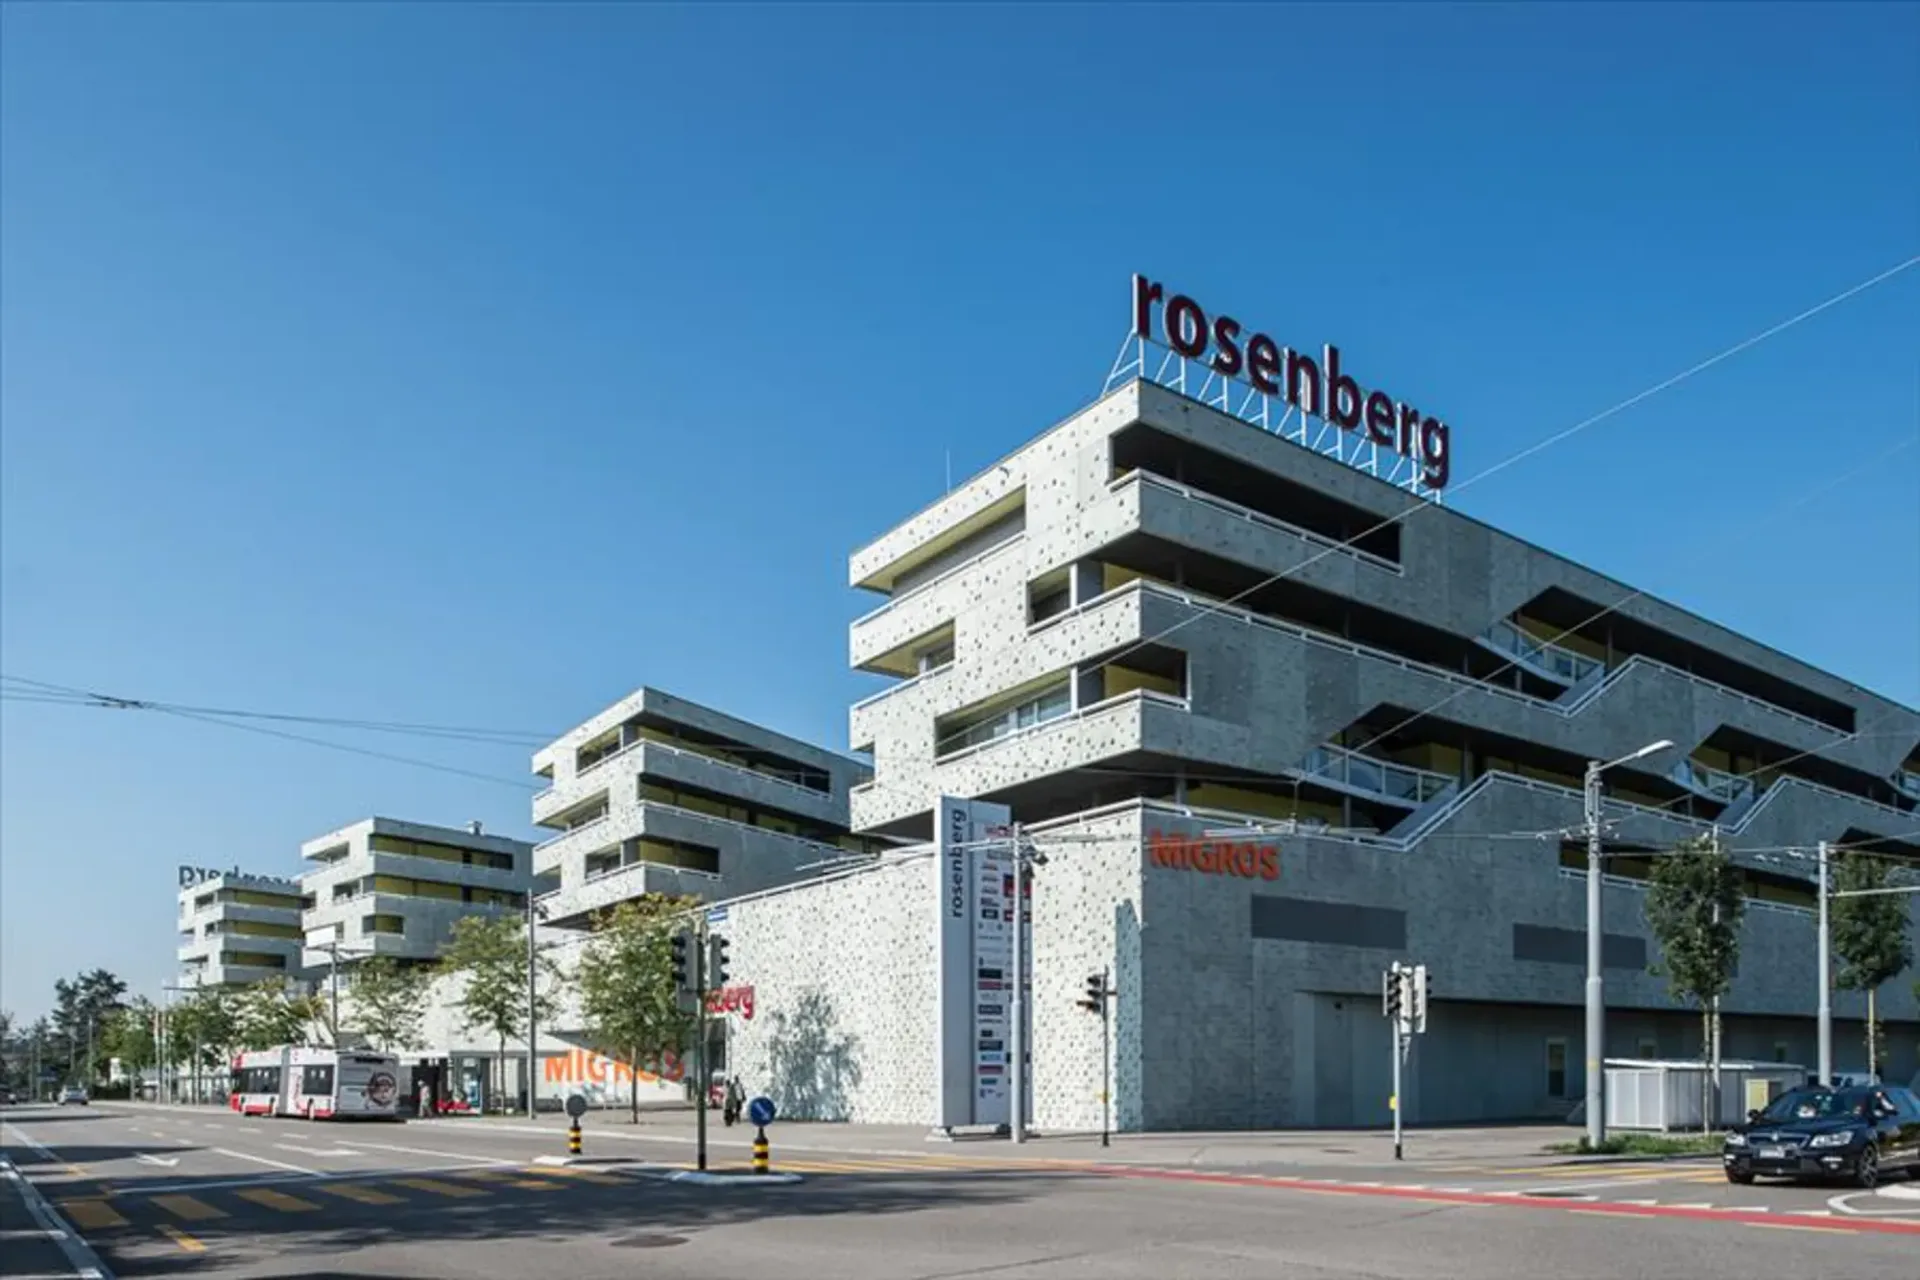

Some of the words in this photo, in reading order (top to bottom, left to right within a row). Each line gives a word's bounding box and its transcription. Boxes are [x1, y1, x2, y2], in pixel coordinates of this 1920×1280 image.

[1132, 273, 1450, 489] rosenberg
[948, 808, 967, 919] rosenberg
[1150, 828, 1280, 881] MIGROS
